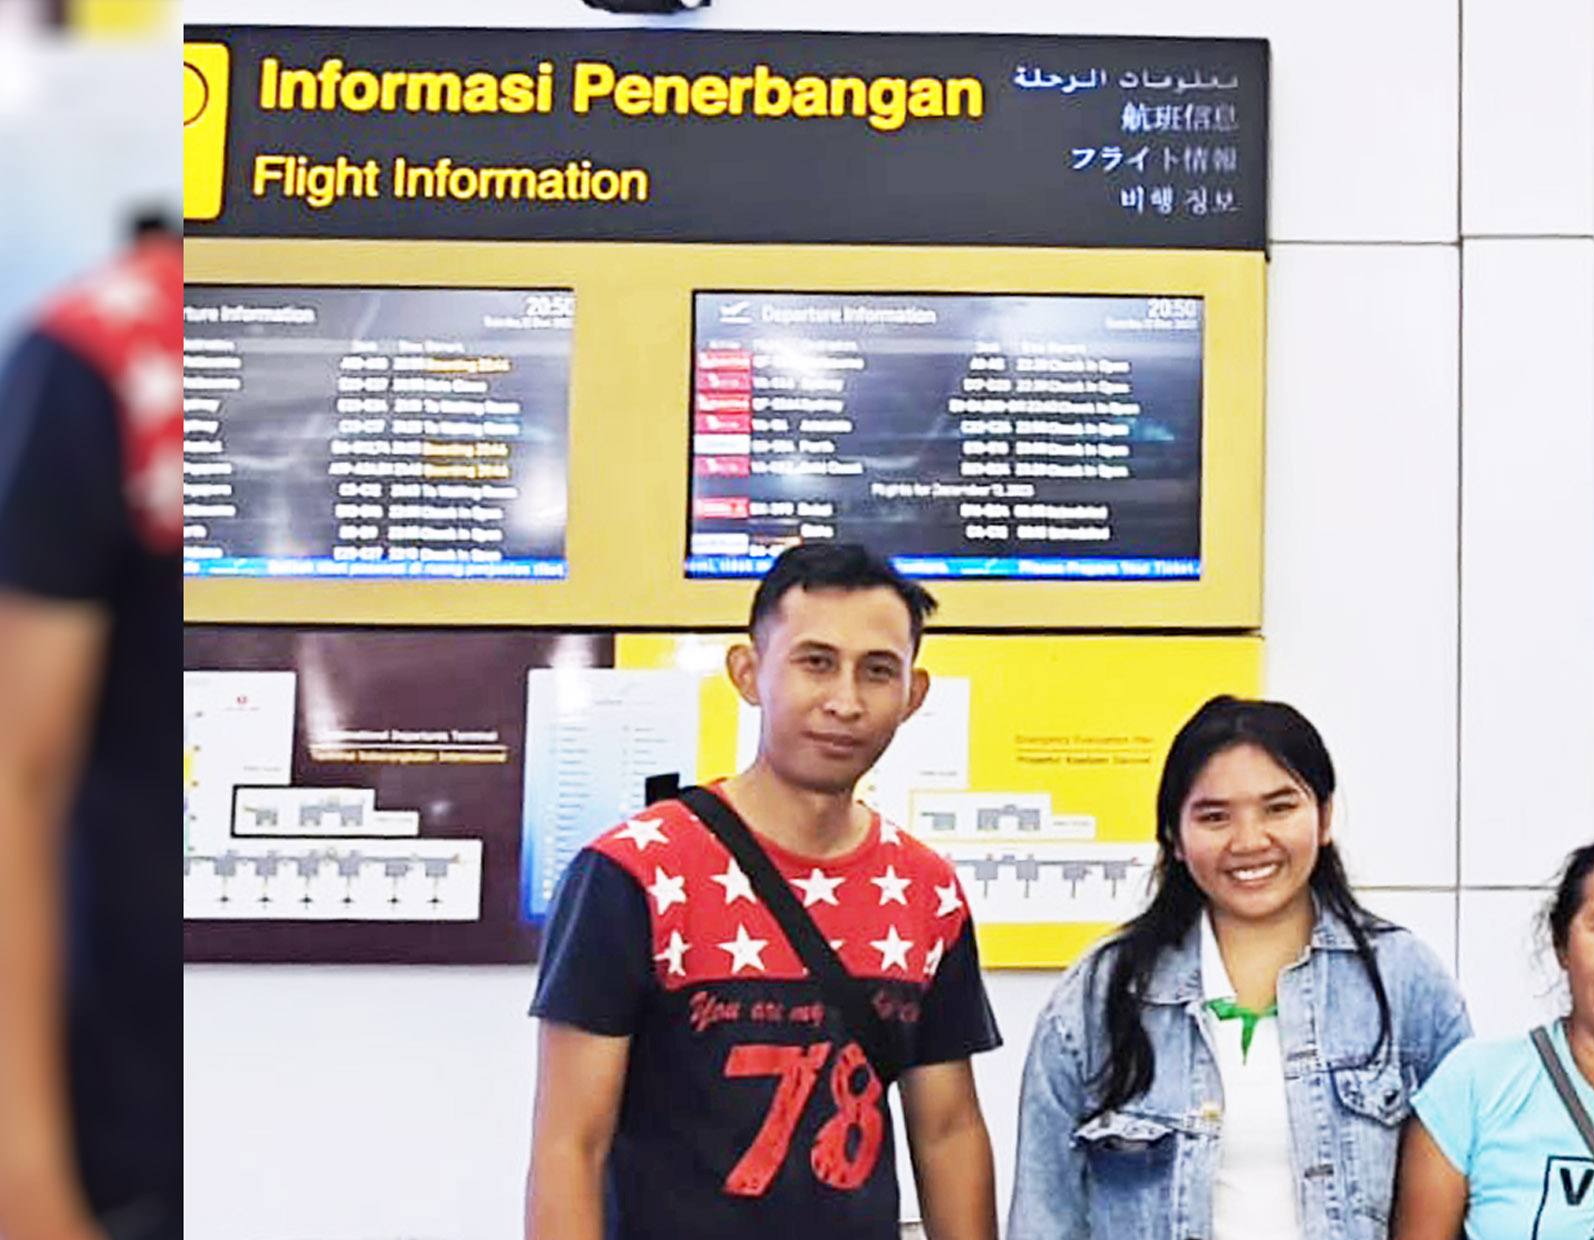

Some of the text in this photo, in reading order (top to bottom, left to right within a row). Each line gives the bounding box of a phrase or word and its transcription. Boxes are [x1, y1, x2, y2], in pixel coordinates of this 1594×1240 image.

[260, 57, 983, 131] Informasi Penerbangan
[253, 155, 649, 207] Flight Information
[762, 306, 842, 325] Departure
[1148, 299, 1196, 317] 20:50
[689, 990, 741, 1032] You
[751, 1001, 787, 1023] are
[723, 1040, 885, 1197] 78
